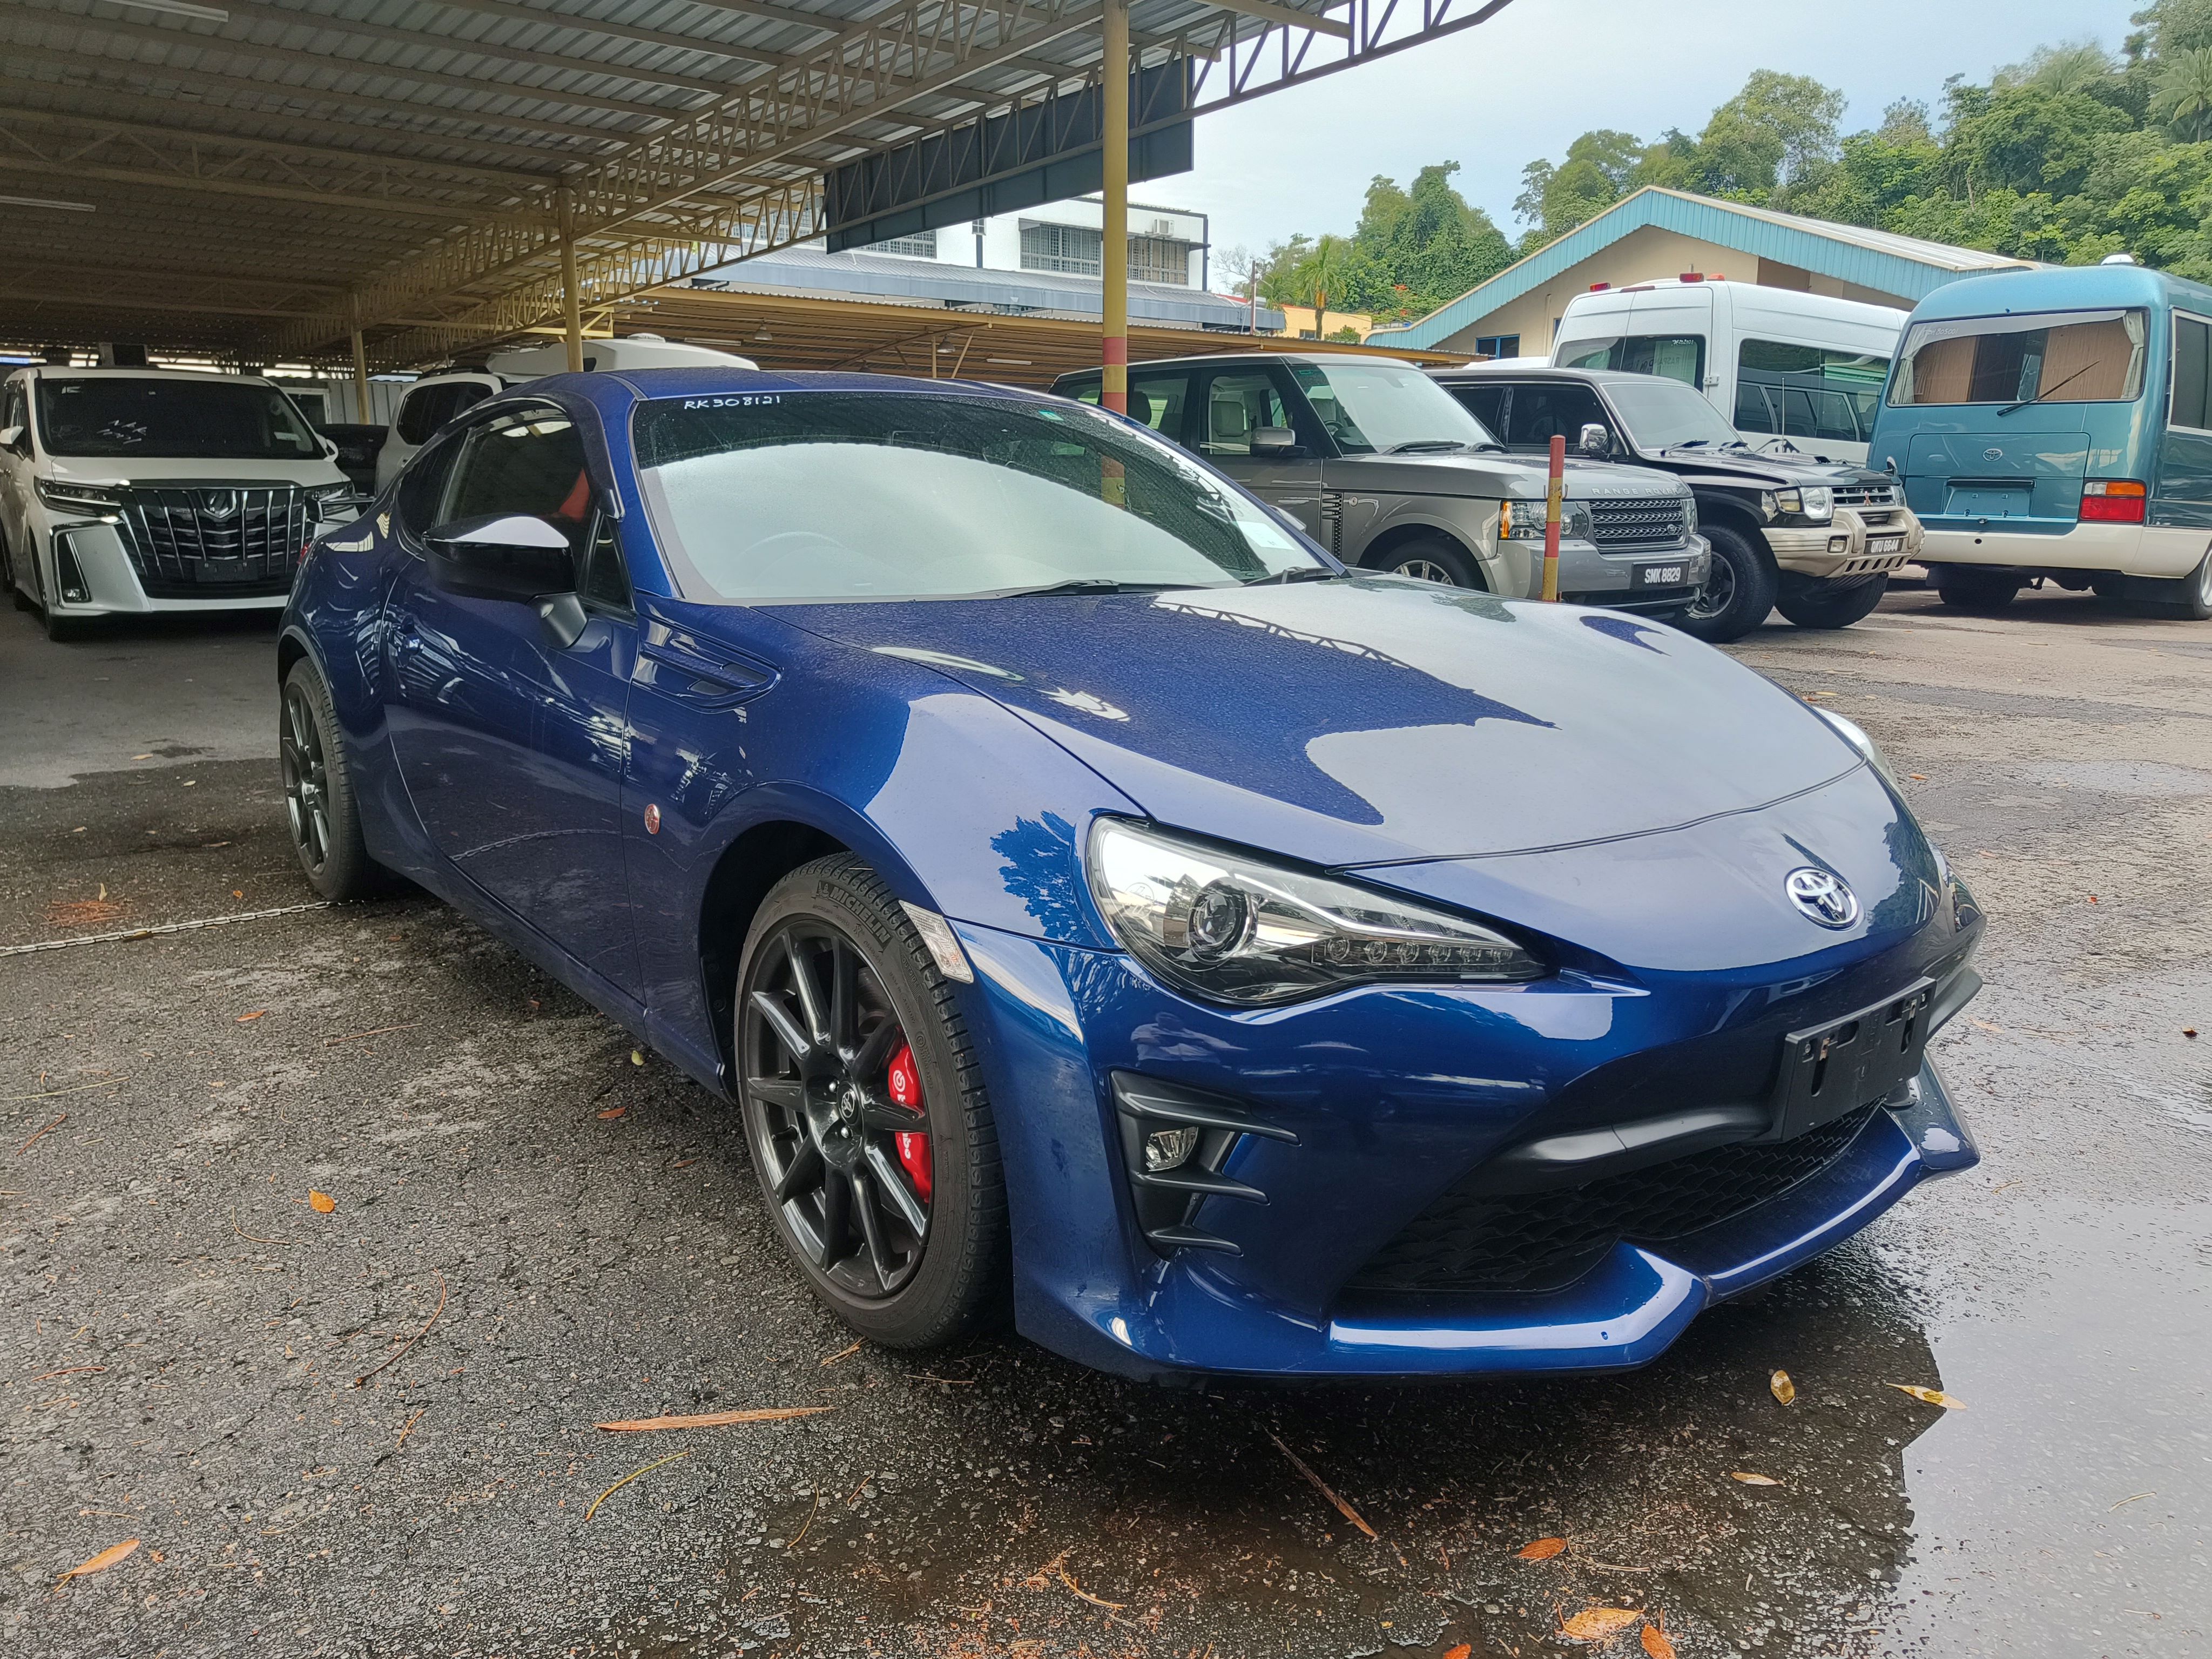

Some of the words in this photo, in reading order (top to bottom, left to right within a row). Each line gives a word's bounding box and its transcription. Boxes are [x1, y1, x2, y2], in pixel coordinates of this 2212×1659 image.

[684, 396, 780, 409] RK308121
[1883, 539, 1899, 551] 6644
[1644, 568, 1661, 583] SMK
[1661, 567, 1681, 582] 8829
[830, 886, 891, 944] MICHELIN
[901, 957, 919, 984] OUTSIDE
